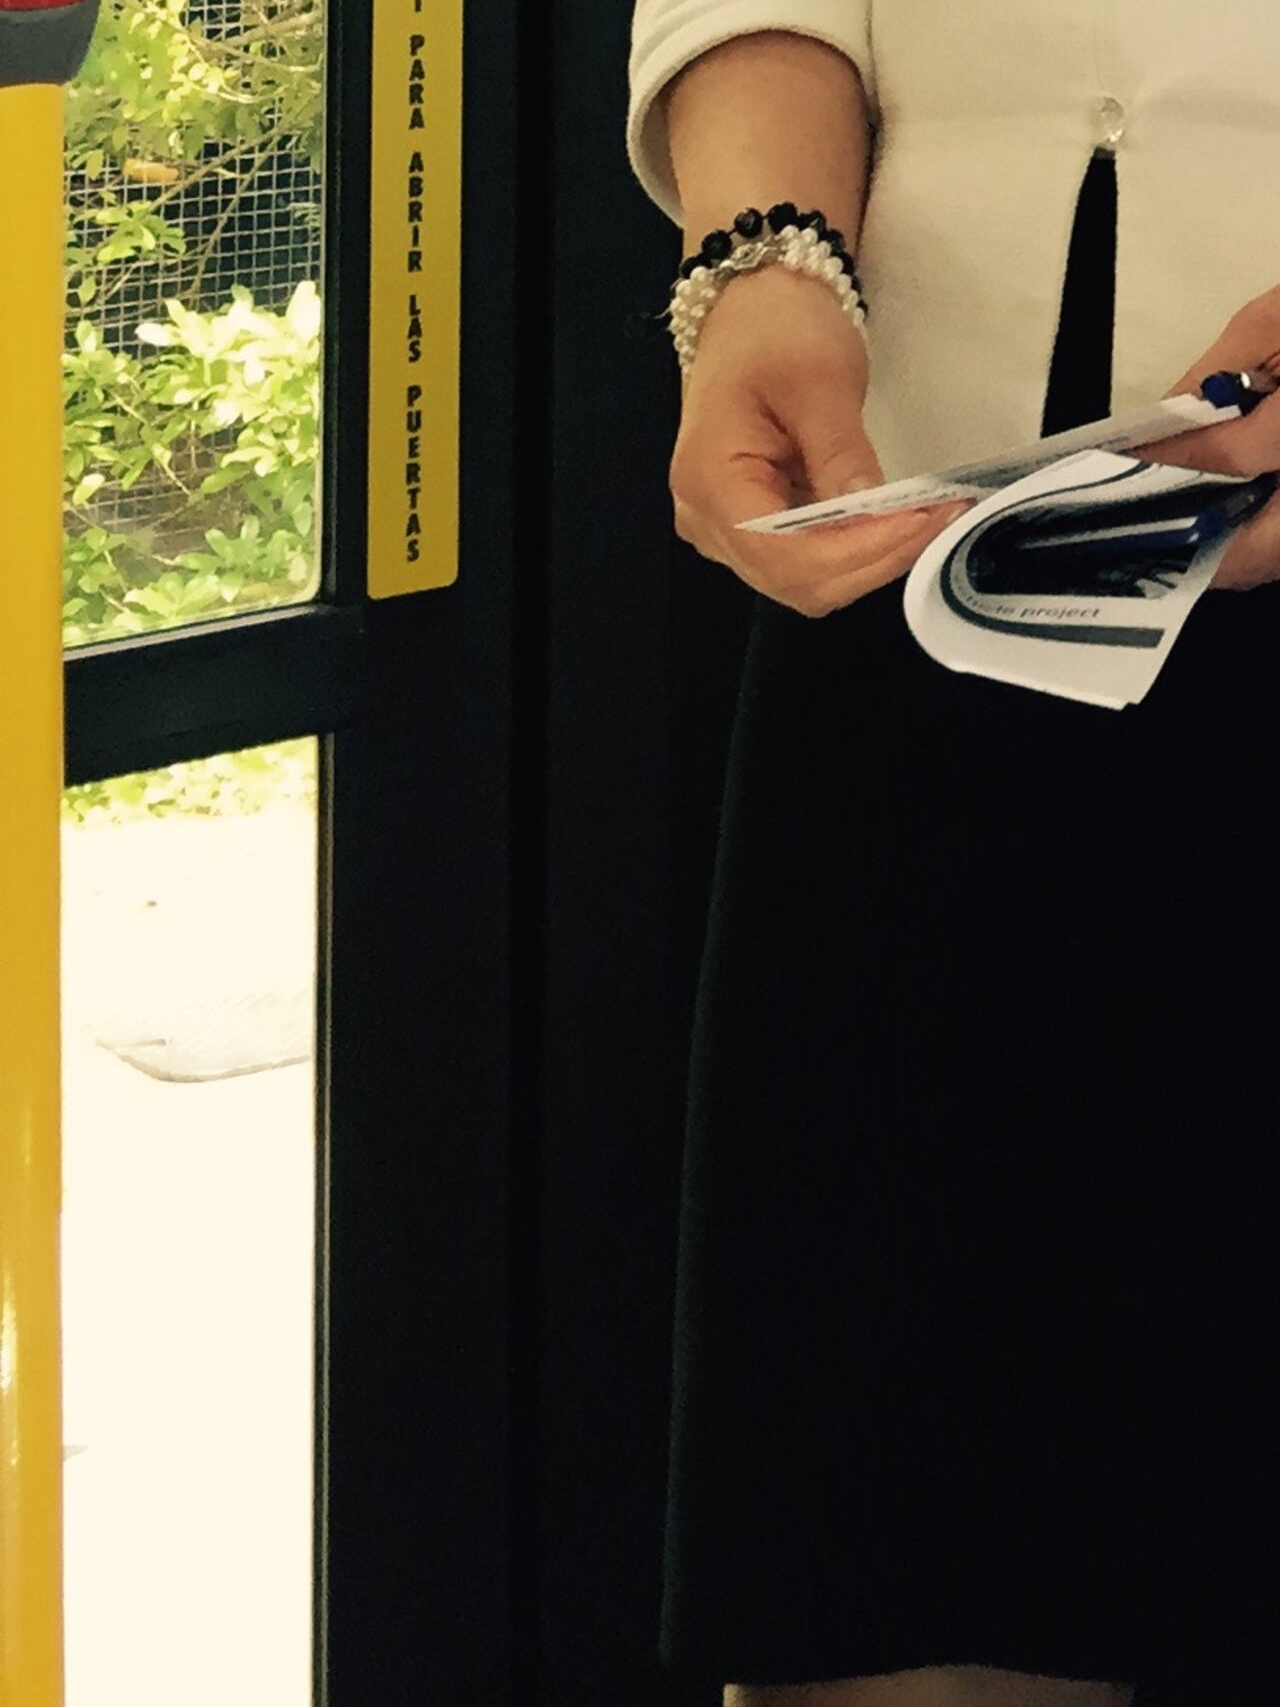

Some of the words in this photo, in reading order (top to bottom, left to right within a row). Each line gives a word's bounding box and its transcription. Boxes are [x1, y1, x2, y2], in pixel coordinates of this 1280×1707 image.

[409, 34, 425, 131] PARA
[407, 151, 423, 273] ABRIR
[407, 293, 422, 363] LAS
[405, 384, 422, 563] PUERTAS
